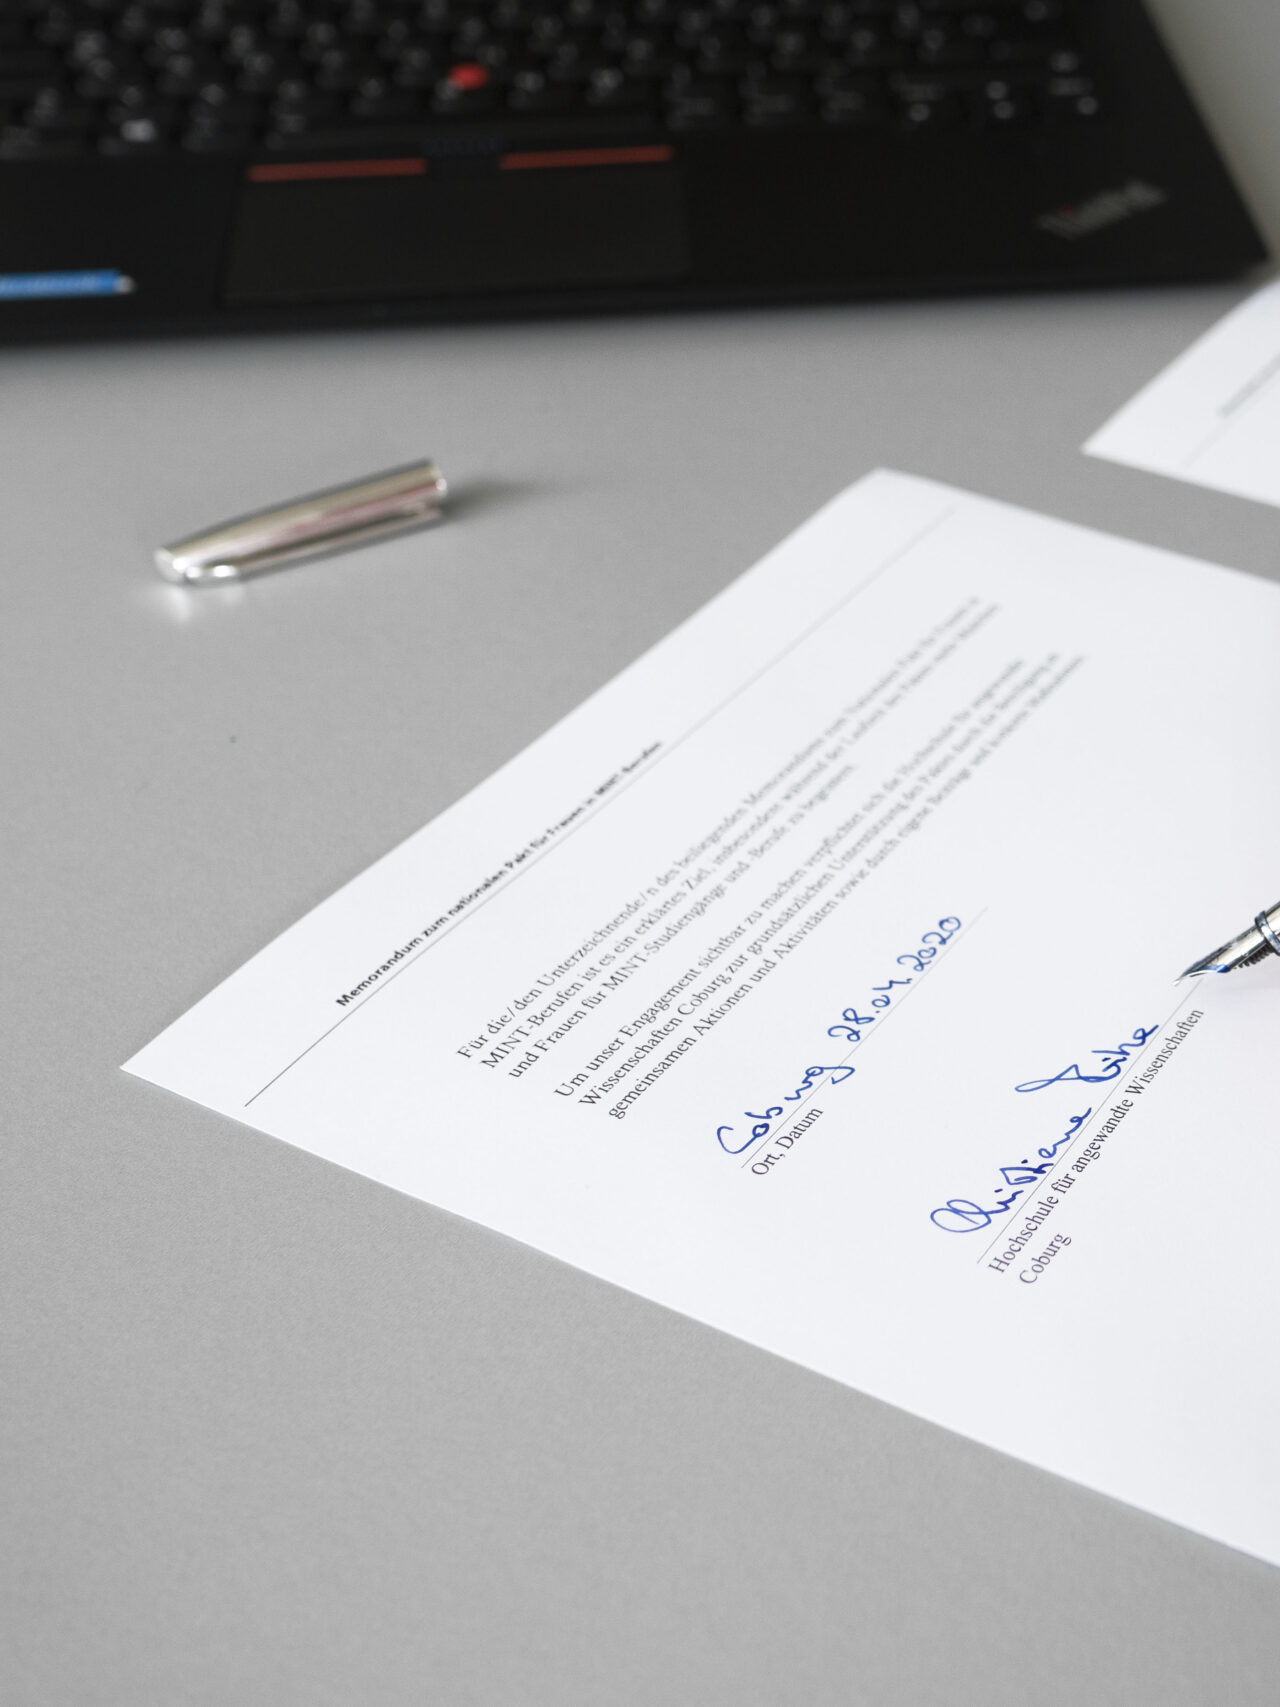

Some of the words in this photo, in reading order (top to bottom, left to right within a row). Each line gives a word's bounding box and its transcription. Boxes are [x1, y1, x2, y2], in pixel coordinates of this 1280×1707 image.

[335, 937, 424, 1007] Memorandum
[421, 916, 449, 938] zum
[447, 870, 508, 917] nationalen
[456, 1034, 489, 1059] Für
[486, 988, 543, 1035] die/den
[536, 887, 659, 987] Unterzeichnende/n
[655, 868, 681, 887] des
[479, 982, 584, 1069] MINT-Berufen
[581, 966, 602, 982] ist
[598, 953, 617, 967] es
[613, 935, 638, 954] ein
[634, 891, 687, 936] erklärtes
[681, 867, 716, 891] Ziel,
[508, 1051, 540, 1078] und
[532, 1010, 587, 1052] Frauen
[581, 990, 607, 1010] für
[600, 883, 726, 991] MINT-Studiengänge
[723, 860, 751, 883] und
[553, 1073, 590, 1097] Um
[585, 1037, 625, 1071] unser
[618, 968, 702, 1038] Engagement
[697, 924, 747, 969] sichtbar
[744, 910, 763, 926] zu
[759, 868, 808, 910] machen
[577, 1017, 683, 1105] Wissenschaften
[676, 973, 732, 1016] Coburg
[725, 954, 749, 975] zur
[746, 872, 835, 956] grundsätzlichen
[608, 1037, 697, 1120] gemeinsamen
[692, 983, 753, 1037] Aktionen
[749, 958, 777, 983] und
[772, 900, 839, 960] Aktivitäten
[834, 868, 870, 900] sowie
[751, 1153, 786, 1175] Ort,
[774, 1108, 824, 1150] Datum
[987, 1196, 1060, 1273] Hochschule
[1050, 1173, 1076, 1195] für
[1071, 1099, 1134, 1173] angewandte
[1124, 1010, 1204, 1095] Wissenschaften
[1019, 1233, 1072, 1284] Coburg
